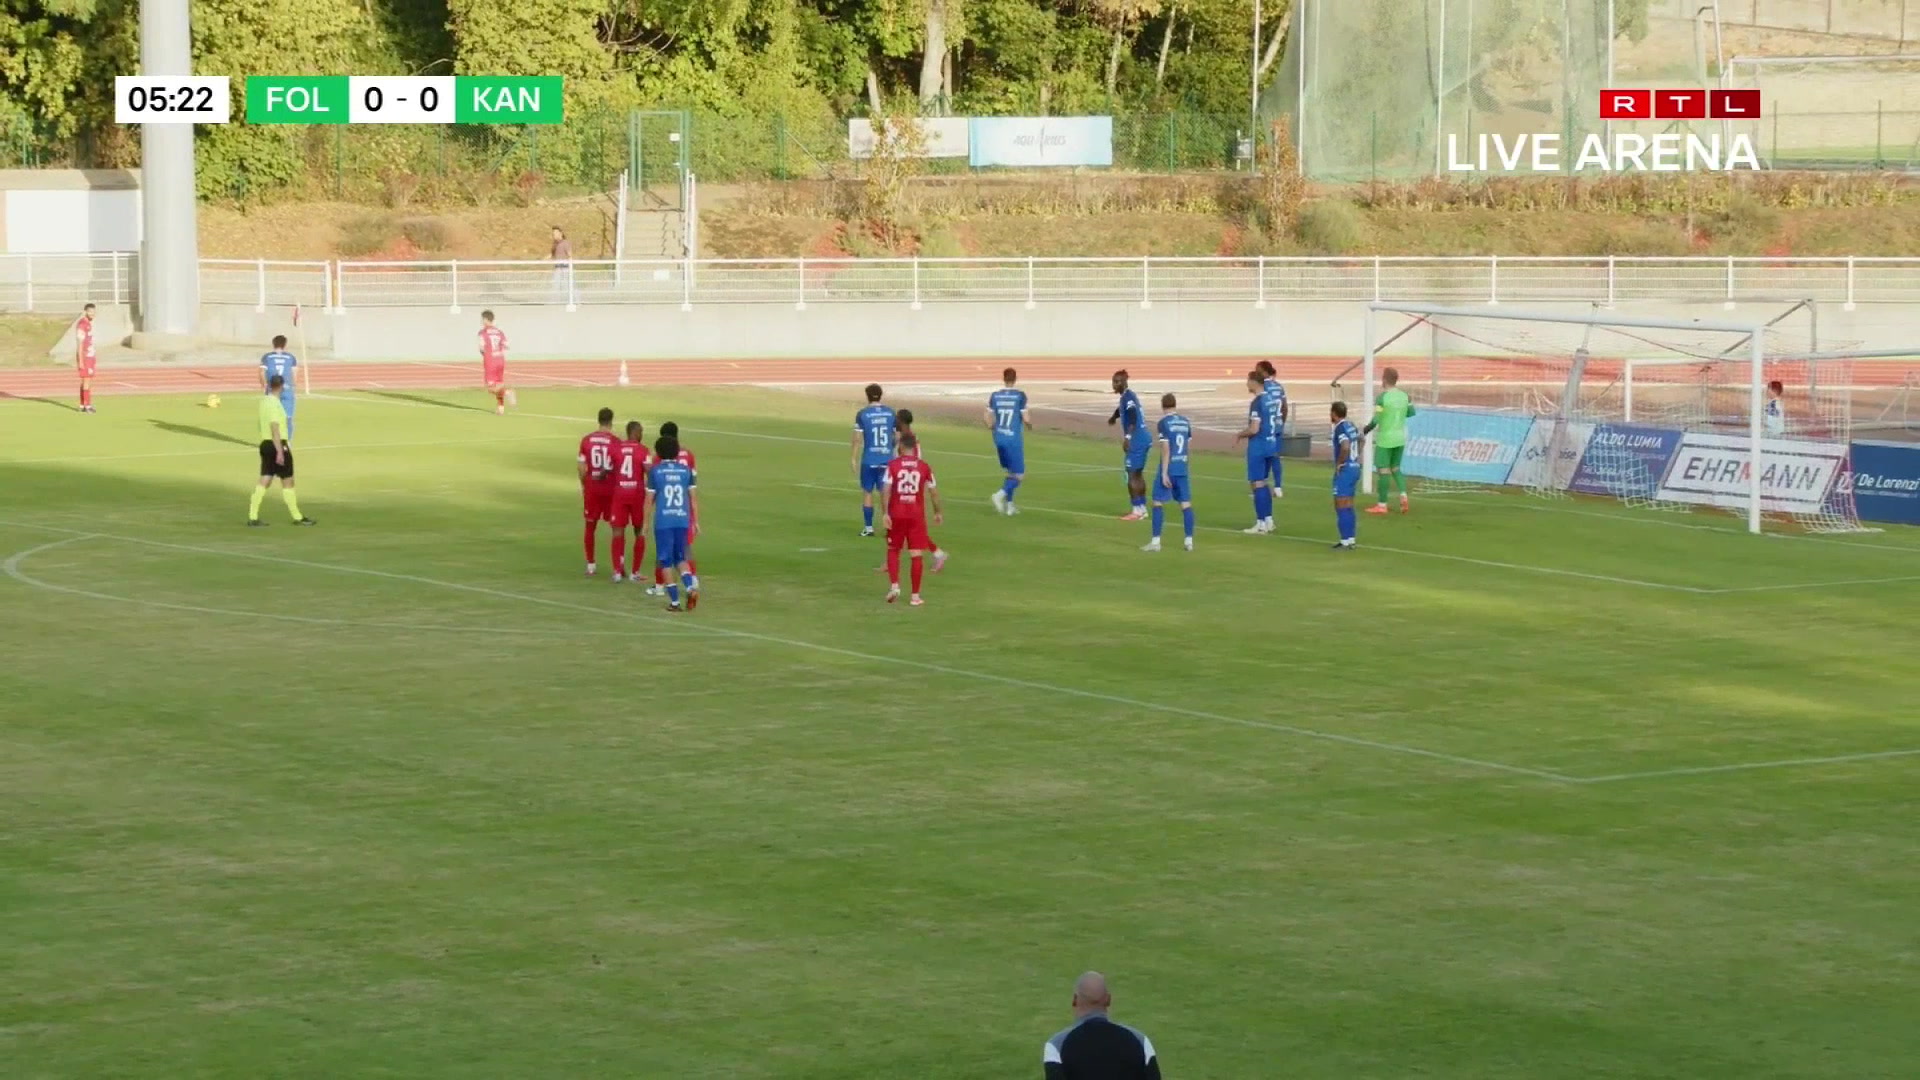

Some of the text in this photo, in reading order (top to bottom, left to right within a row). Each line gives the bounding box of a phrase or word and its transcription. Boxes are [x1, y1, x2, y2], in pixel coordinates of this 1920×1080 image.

[998, 409, 1014, 428] 77
[871, 426, 889, 447] 15
[1176, 433, 1185, 455] 9
[1594, 433, 1663, 449] ALDO LUMIA
[620, 455, 633, 479] 4
[897, 469, 921, 495] 29
[1857, 473, 1875, 487] De
[1875, 475, 1920, 491] Lorenzi
[664, 484, 684, 508] 93
